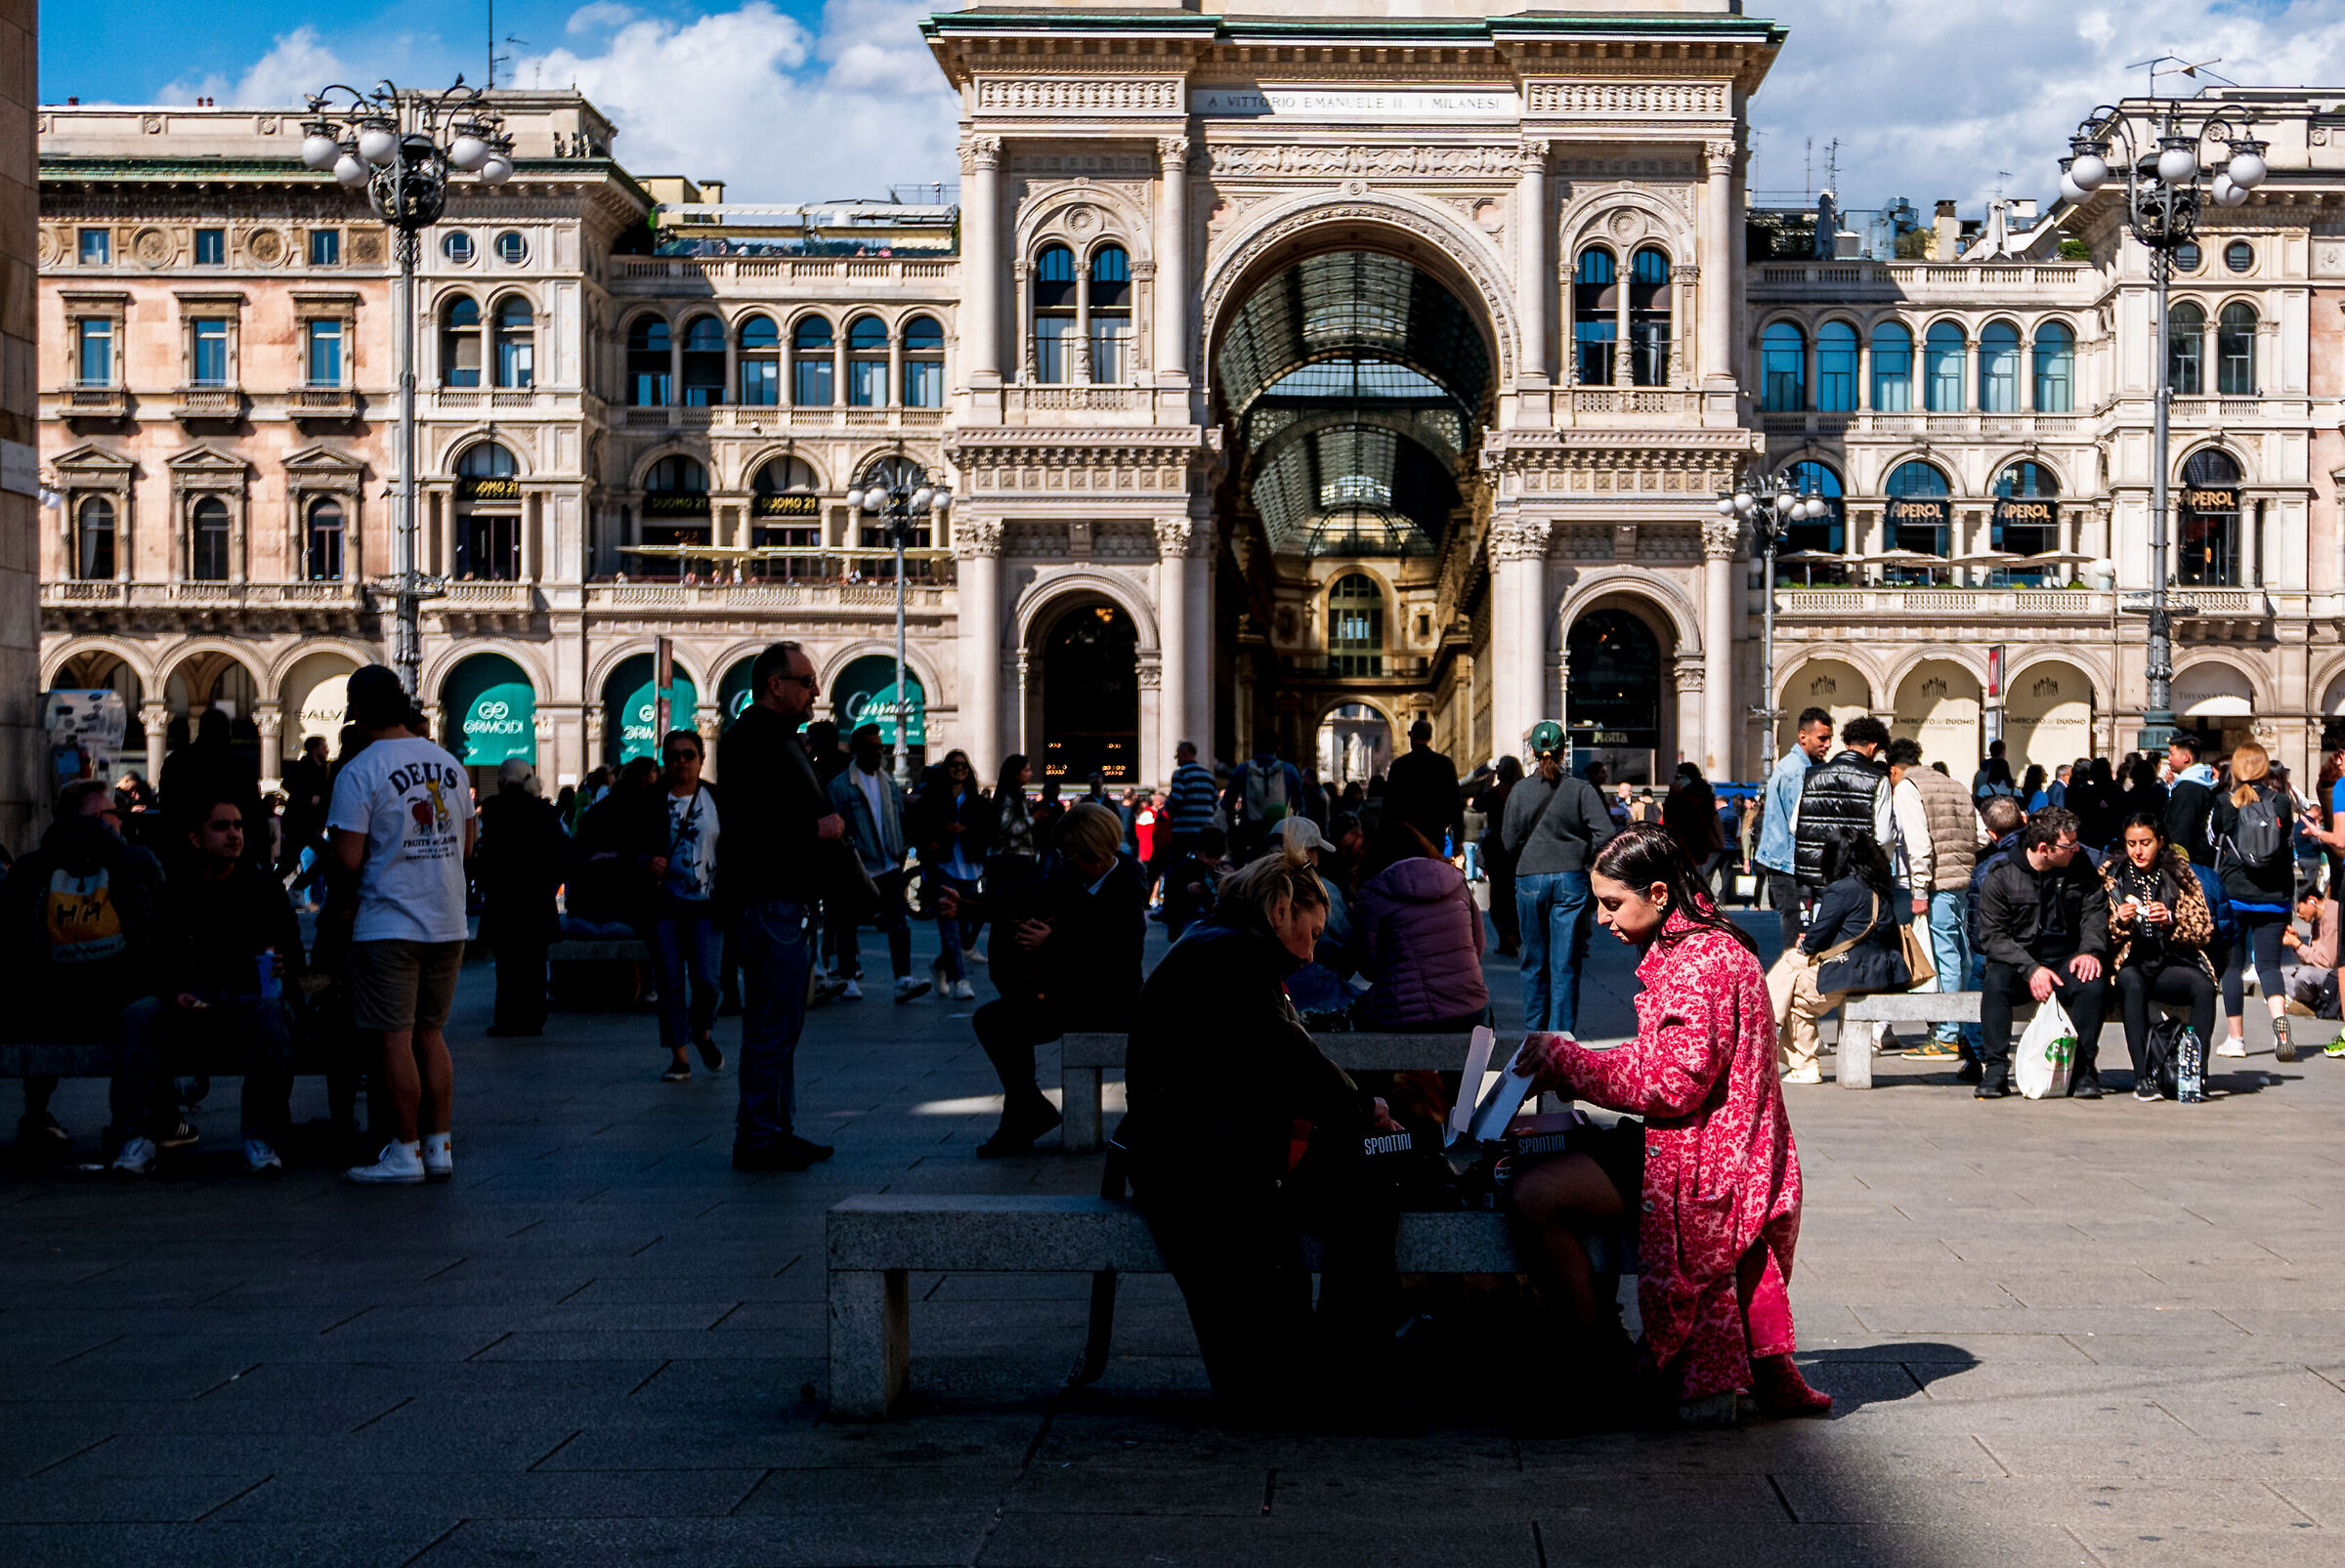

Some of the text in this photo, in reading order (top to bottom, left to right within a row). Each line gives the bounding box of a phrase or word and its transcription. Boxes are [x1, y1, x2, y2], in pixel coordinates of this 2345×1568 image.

[1209, 98, 1217, 107] A
[1227, 97, 1296, 107] VITTORIO
[1431, 98, 1500, 108] MILANESI
[695, 496, 706, 509] 21
[761, 496, 816, 509] DUOMO 21
[2180, 489, 2236, 506] APEROL
[1890, 501, 1943, 518] APEROL
[1996, 501, 2051, 518] APEROL
[463, 719, 525, 735] GRIMOLDI
[388, 761, 458, 796] DEUS
[1364, 1133, 1412, 1156] SPONTINI
[1518, 1133, 1566, 1156] SPONTINI
